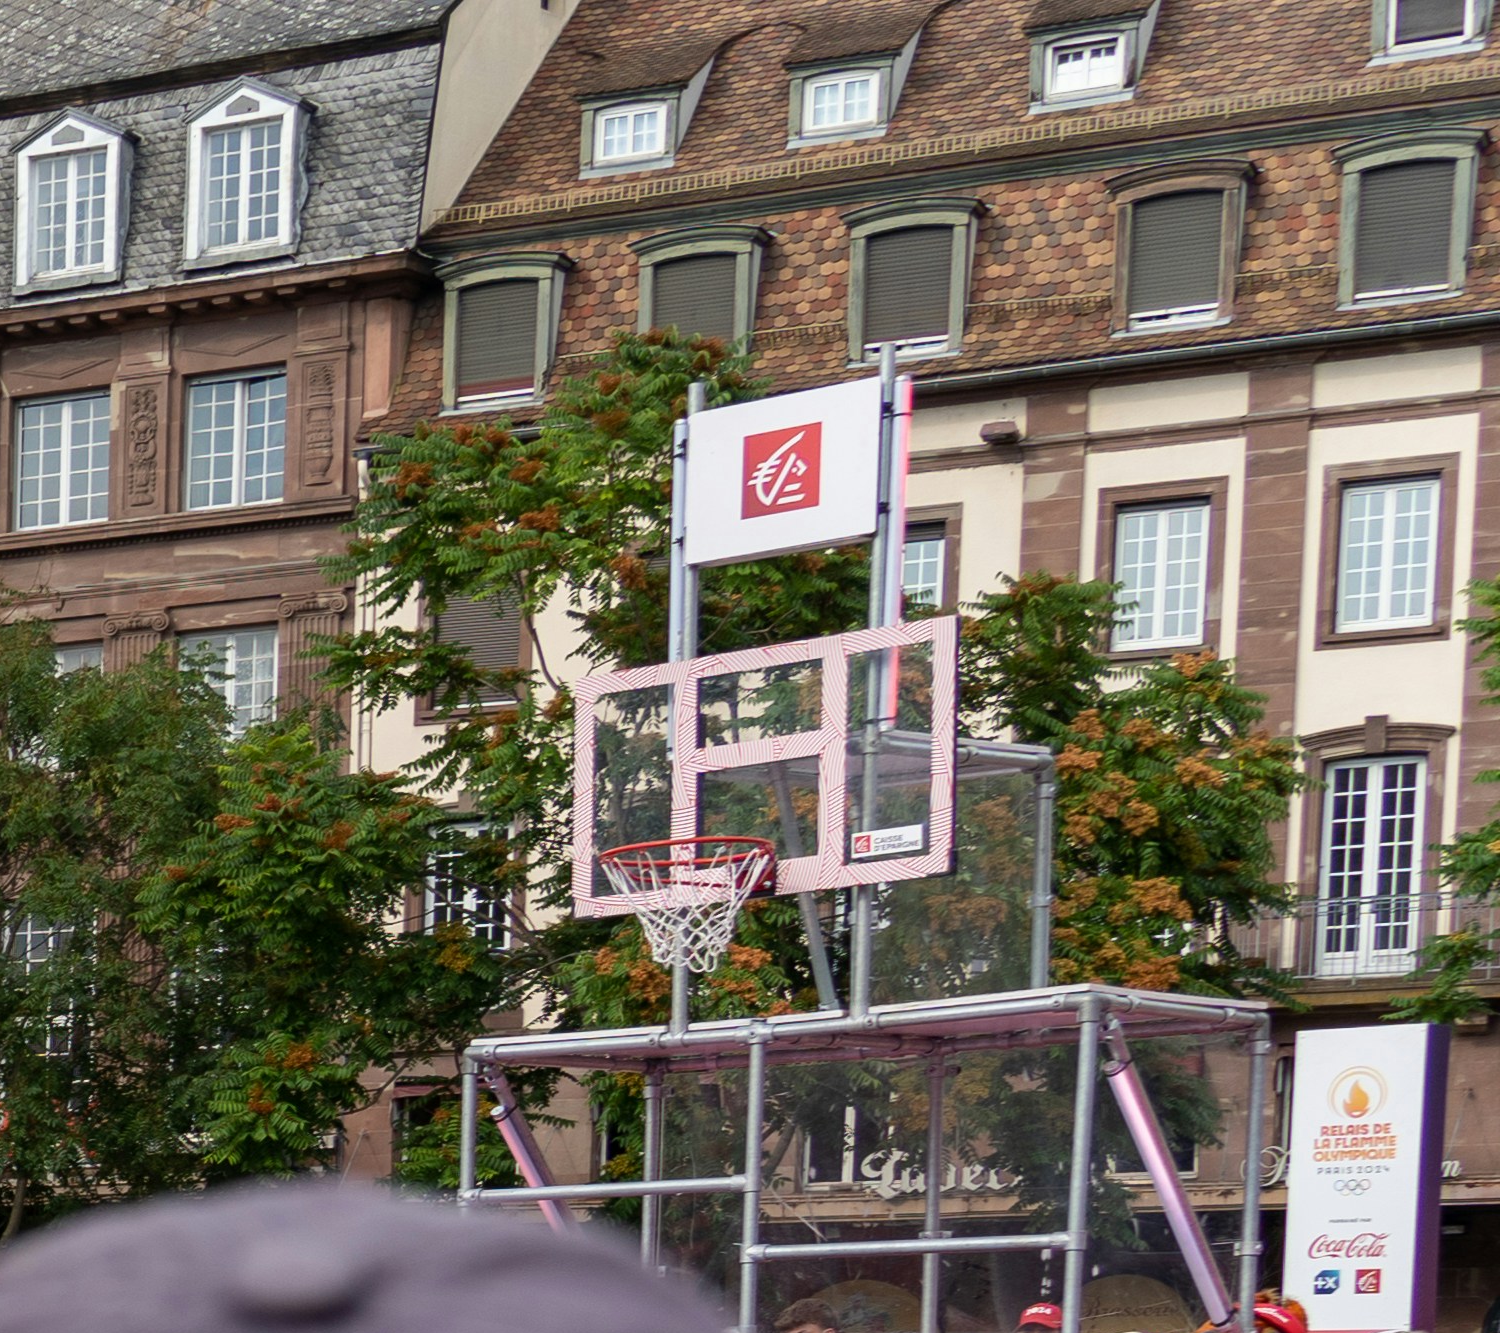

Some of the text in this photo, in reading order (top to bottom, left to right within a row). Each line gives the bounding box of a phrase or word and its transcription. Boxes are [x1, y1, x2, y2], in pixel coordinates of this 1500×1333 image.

[1320, 1122, 1392, 1137] RELAIS DE
[1314, 1135, 1397, 1150] LA FLAMME
[1313, 1148, 1396, 1162] OLYMPIQUE
[1317, 1165, 1390, 1175] PARIS 2024
